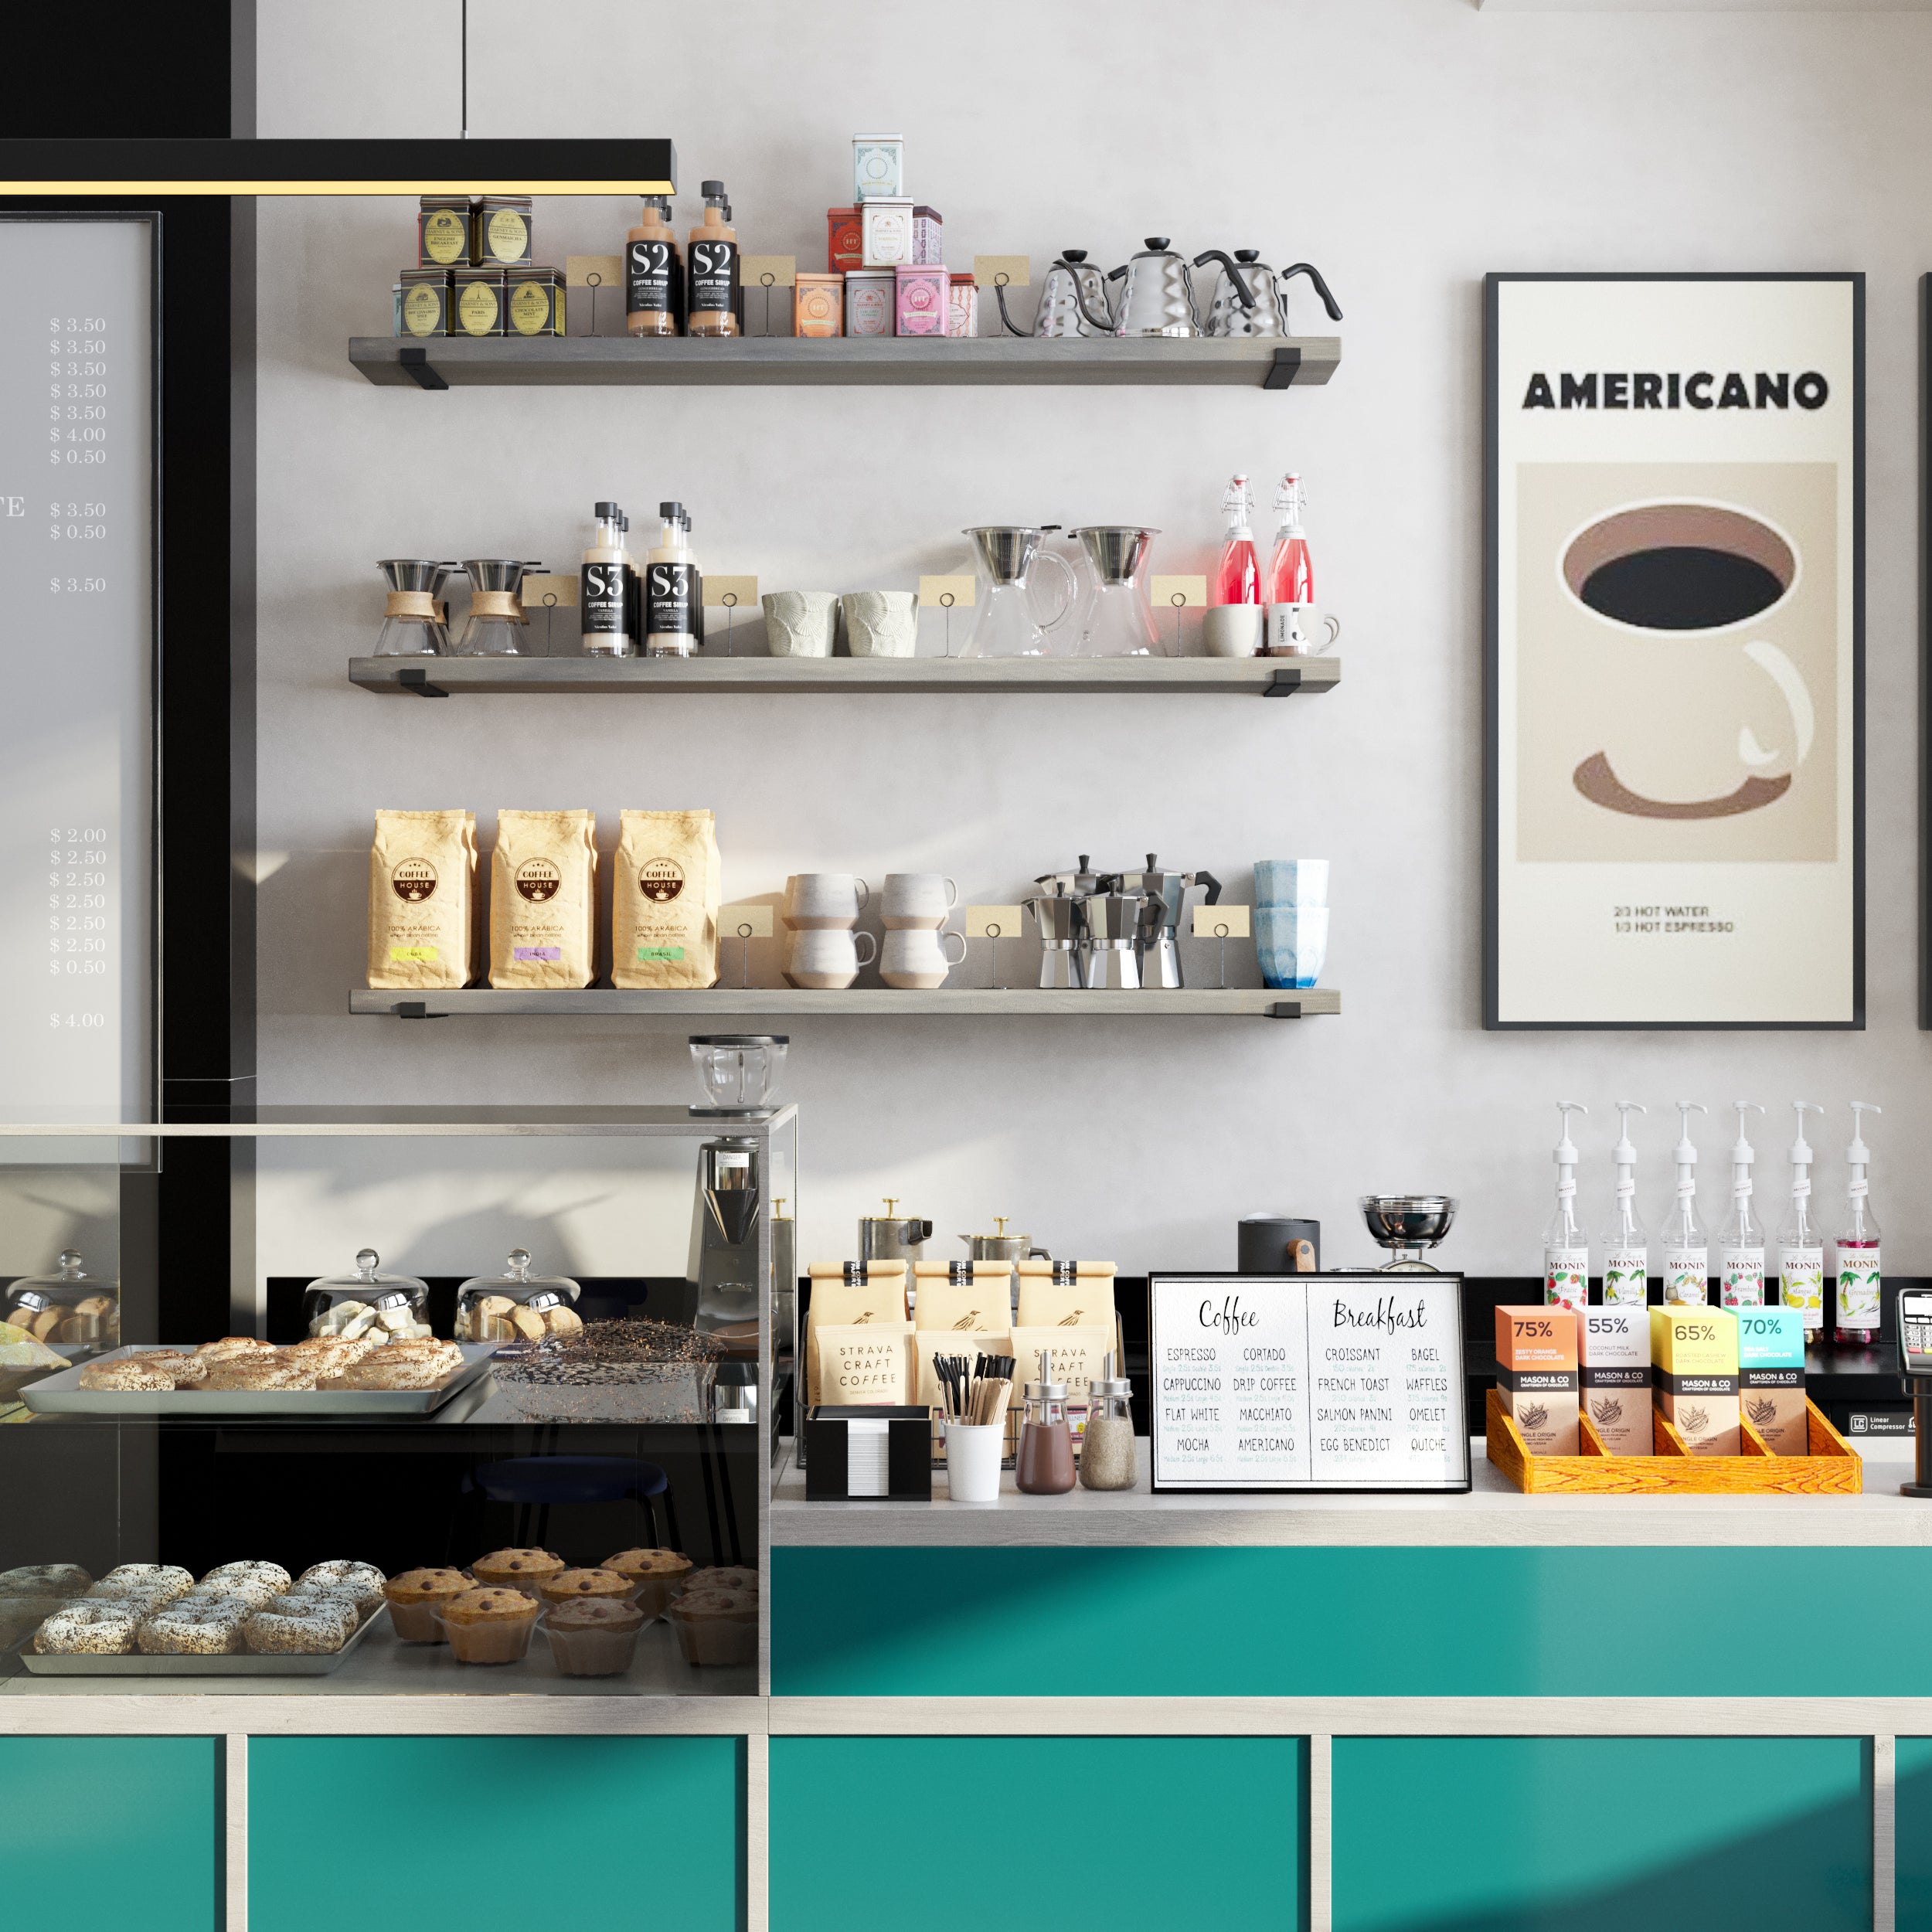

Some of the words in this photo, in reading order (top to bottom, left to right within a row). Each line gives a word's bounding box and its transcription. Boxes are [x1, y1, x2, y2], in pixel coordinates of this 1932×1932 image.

[631, 243, 668, 276] S2
[693, 243, 731, 276] S2
[67, 318, 105, 332] 3.50
[67, 340, 105, 353] 3.50
[68, 362, 106, 376] 3.50
[68, 384, 106, 397] 3.50
[1521, 372, 1830, 410] AMERICANO
[68, 406, 105, 420] 3.50
[67, 428, 105, 441] 4.00
[67, 450, 105, 463] 0.50
[68, 503, 105, 516] 3.50
[67, 526, 105, 539] 0.50
[68, 578, 105, 591] 3.50
[587, 566, 623, 597] S3
[651, 566, 689, 597] S3
[68, 829, 106, 842] 2.00
[68, 851, 106, 864] 2.50
[66, 872, 105, 886] 2.50
[67, 893, 104, 908] 2.50
[1636, 907, 1660, 917] HOT
[1665, 906, 1709, 917] WATER
[67, 917, 105, 930] 2.50
[1636, 923, 1661, 932] HOT
[1665, 922, 1733, 932] ESPRESSO
[67, 938, 105, 951] 2.50
[67, 961, 105, 974] 0.50
[66, 1014, 104, 1026] 4.00
[1199, 1296, 1259, 1335] Coffee
[1333, 1296, 1427, 1335] Breakfast
[1514, 1321, 1553, 1337] 75%
[1589, 1318, 1628, 1333] 55%
[1742, 1319, 1781, 1334] 70%
[1675, 1325, 1716, 1340] 65%
[840, 1345, 893, 1355] STRAVA
[1167, 1349, 1216, 1361] ESPRESSO
[1243, 1349, 1286, 1361] CORTADO
[1325, 1349, 1380, 1361] CROISSANT
[1411, 1349, 1440, 1361] BAGEL
[844, 1359, 890, 1369] CRAFT
[840, 1373, 896, 1386] COFFEE
[1164, 1379, 1221, 1391] CAPPUCCINO
[1233, 1379, 1255, 1391] DRIP
[1260, 1379, 1297, 1391] COFFEE
[1318, 1379, 1355, 1391] FRENCH
[1359, 1379, 1389, 1391] TOAST
[1406, 1379, 1447, 1391] WAFFLES
[1165, 1408, 1187, 1421] FLAT
[1191, 1408, 1219, 1421] WHITE
[1240, 1408, 1291, 1421] MACCHIATO
[1317, 1408, 1355, 1421] SALMON
[1359, 1408, 1392, 1421] PANINI
[1410, 1408, 1446, 1421] OMELET
[1177, 1439, 1209, 1451] MOCHA
[1238, 1439, 1294, 1451] AMERICANO
[1320, 1439, 1339, 1451] EGG
[1342, 1439, 1390, 1451] BENEDICT
[1411, 1439, 1447, 1451] QUICHE
